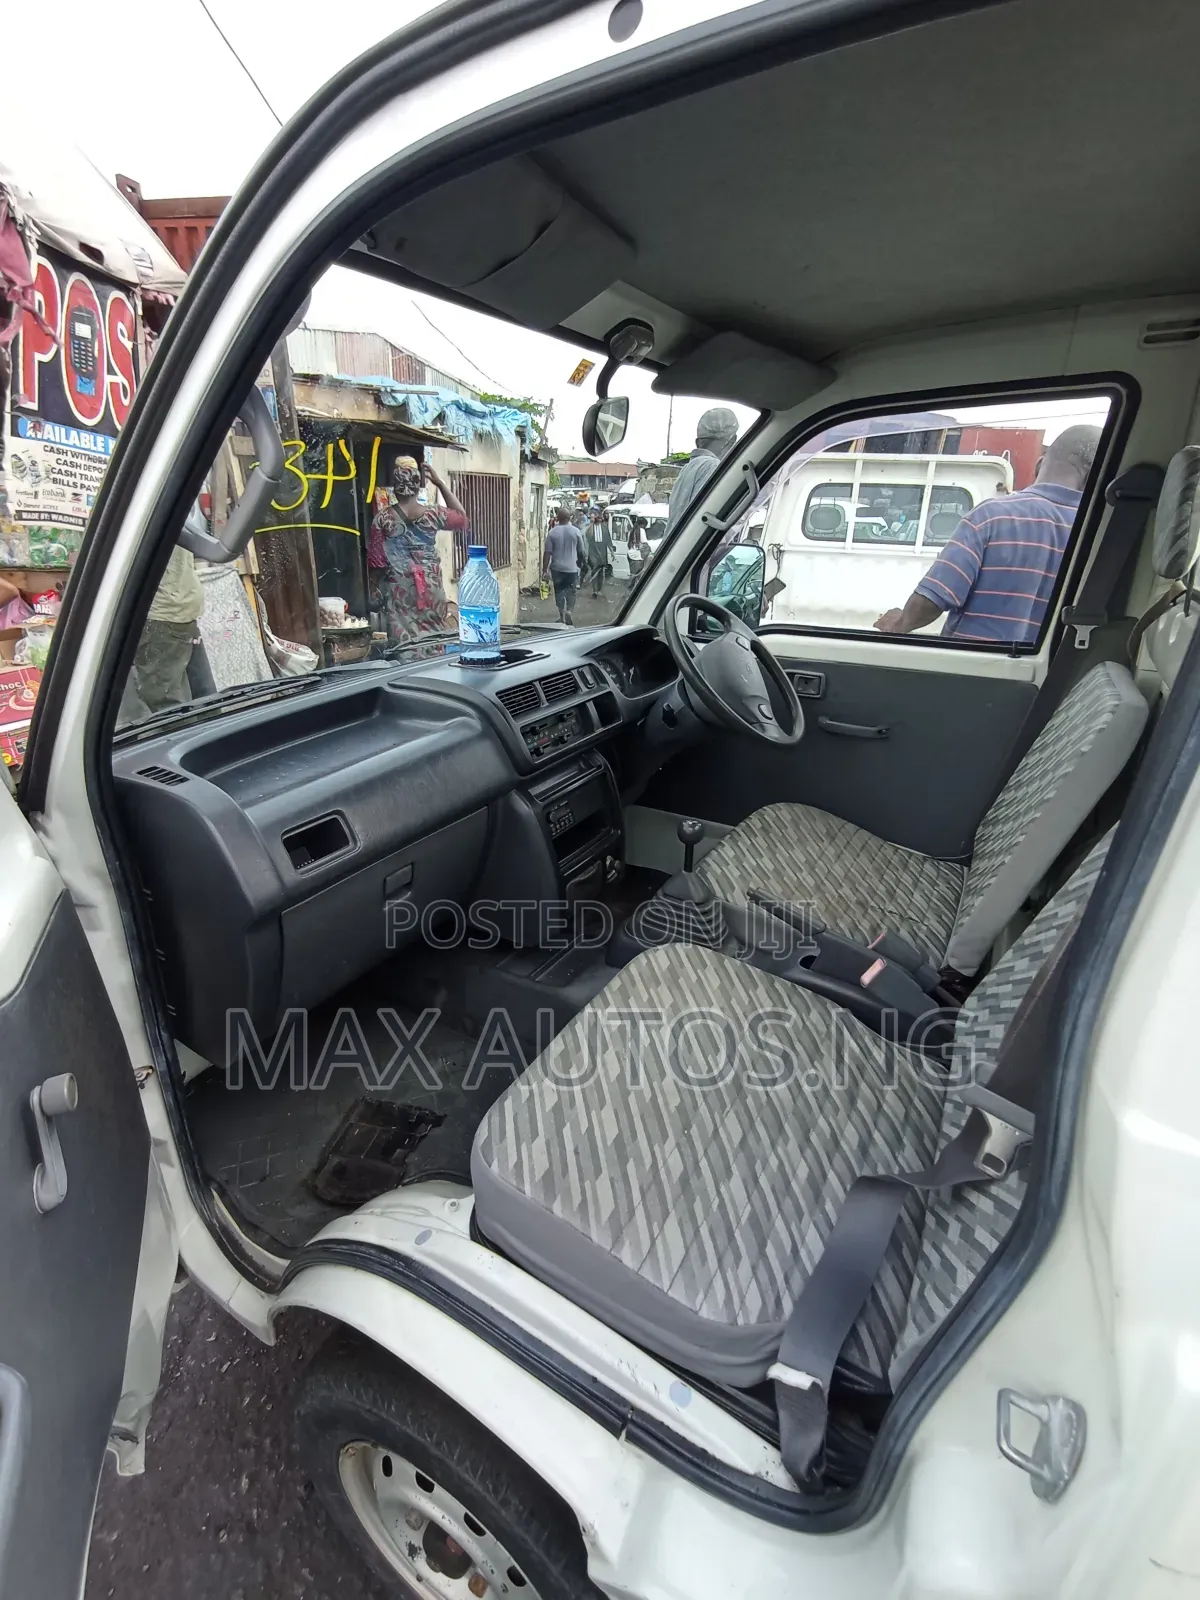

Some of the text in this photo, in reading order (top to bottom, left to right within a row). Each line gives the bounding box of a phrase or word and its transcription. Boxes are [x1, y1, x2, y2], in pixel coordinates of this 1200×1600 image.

[18, 255, 136, 431] POS
[43, 445, 69, 457] CASH
[56, 458, 82, 470] CASH
[51, 467, 77, 479] CASH
[52, 477, 100, 493] BILLS PAY
[42, 488, 67, 499] Ecobank
